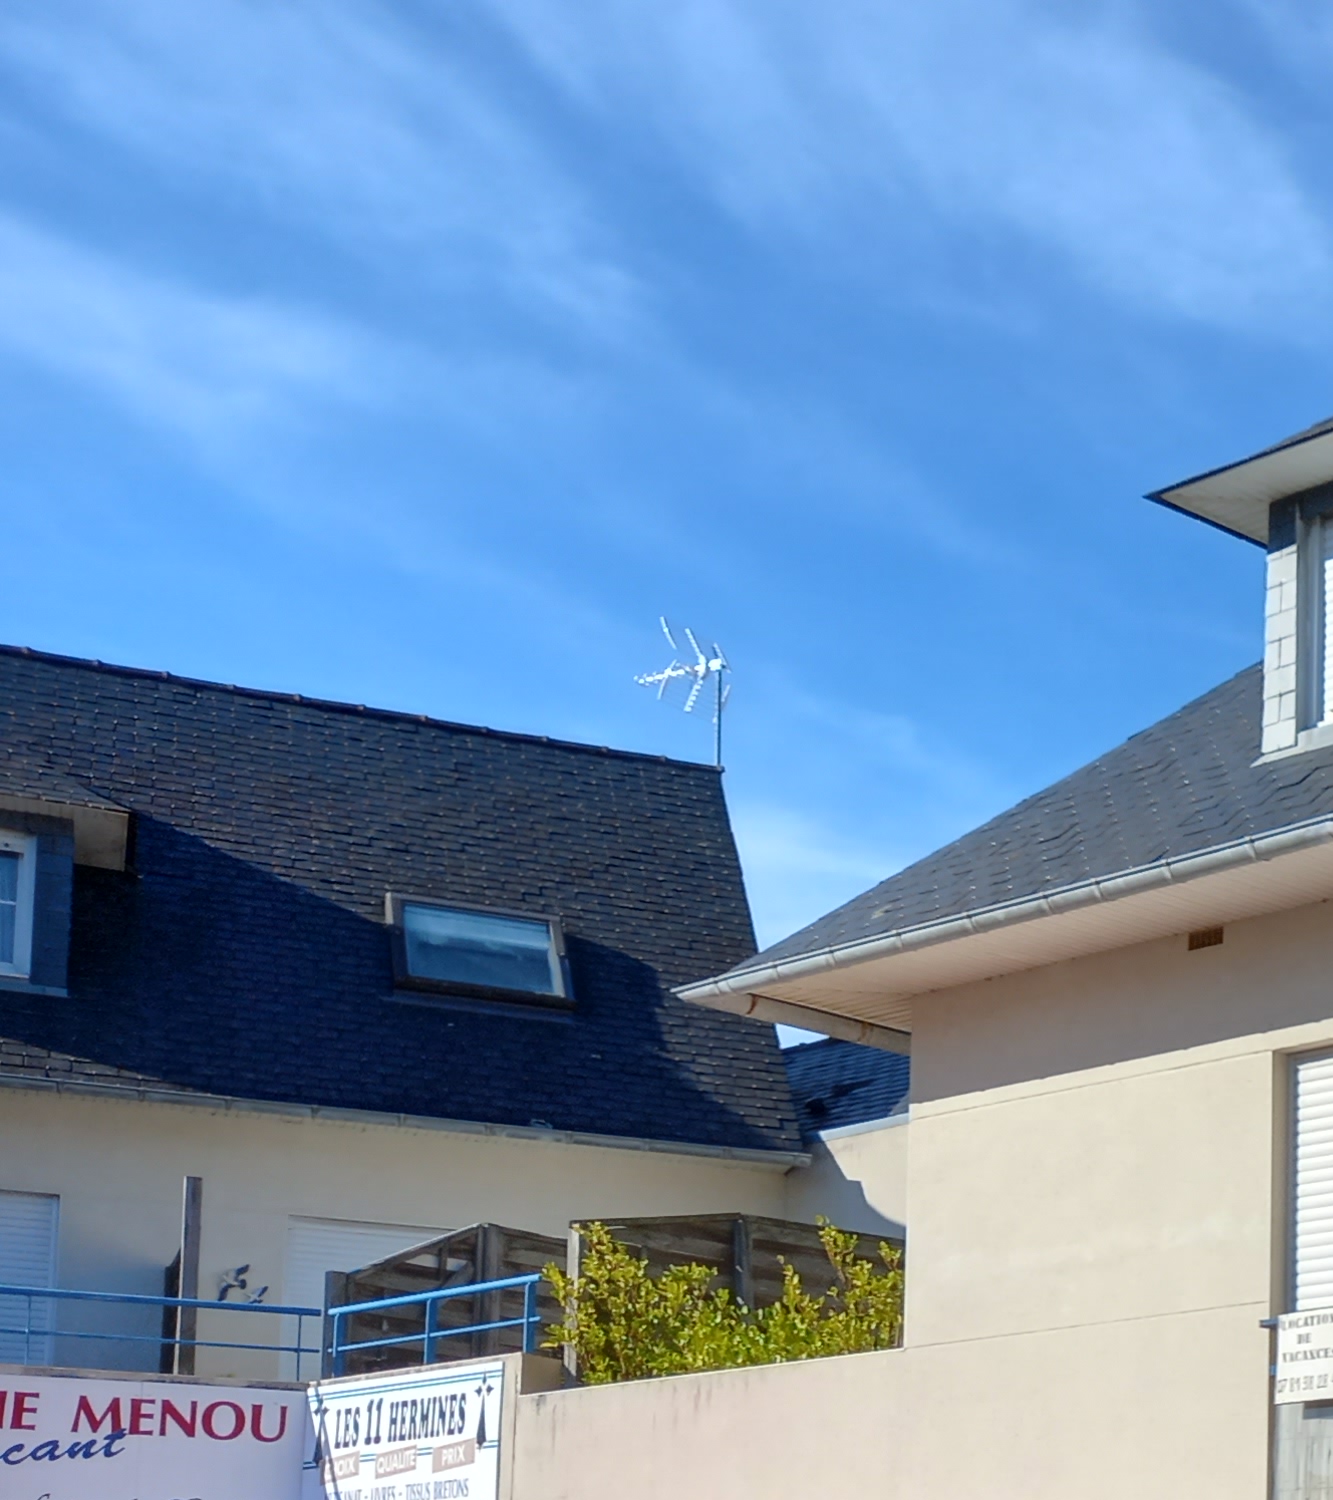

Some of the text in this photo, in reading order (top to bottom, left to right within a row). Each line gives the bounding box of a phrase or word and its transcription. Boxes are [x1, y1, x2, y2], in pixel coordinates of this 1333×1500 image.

[71, 1395, 288, 1442] MENOU
[334, 1393, 467, 1449] LES 11 HERMINES
[441, 1445, 466, 1467] PRIX
[434, 1478, 469, 1500] BRETONS
